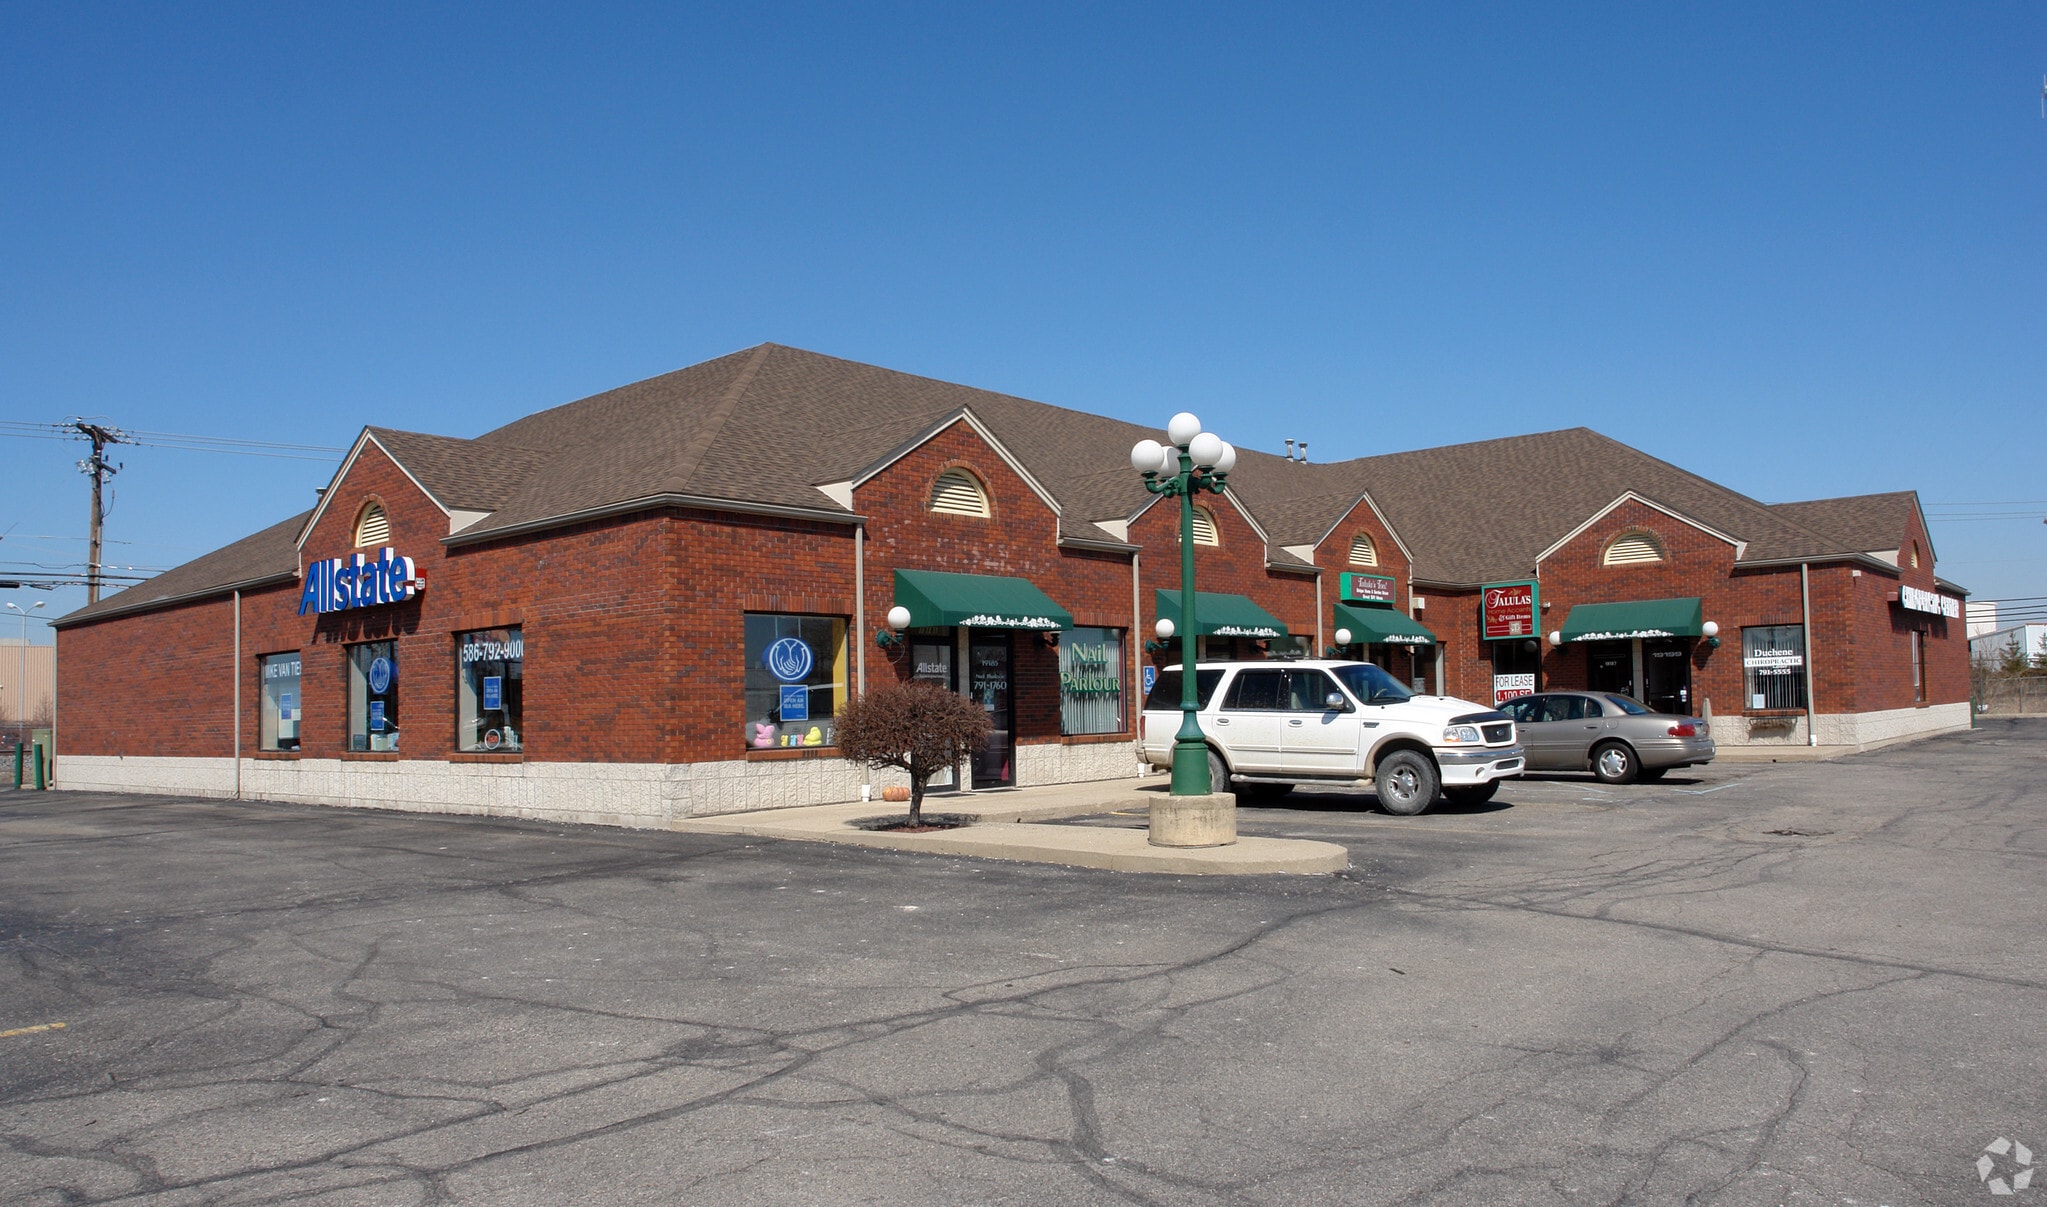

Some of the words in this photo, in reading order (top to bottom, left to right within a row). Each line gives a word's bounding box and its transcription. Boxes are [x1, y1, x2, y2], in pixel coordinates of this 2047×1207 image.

[297, 547, 416, 616] Allstate
[1746, 657, 1802, 666] CHIROPRACTIC
[278, 662, 290, 677] VAN
[916, 662, 948, 673] Allstate
[1758, 668, 1792, 676] 791-5555
[973, 680, 1007, 690] 791-1760
[1495, 676, 1510, 688] FOR
[1510, 675, 1533, 687] LEASE
[1497, 690, 1518, 702] 1,100
